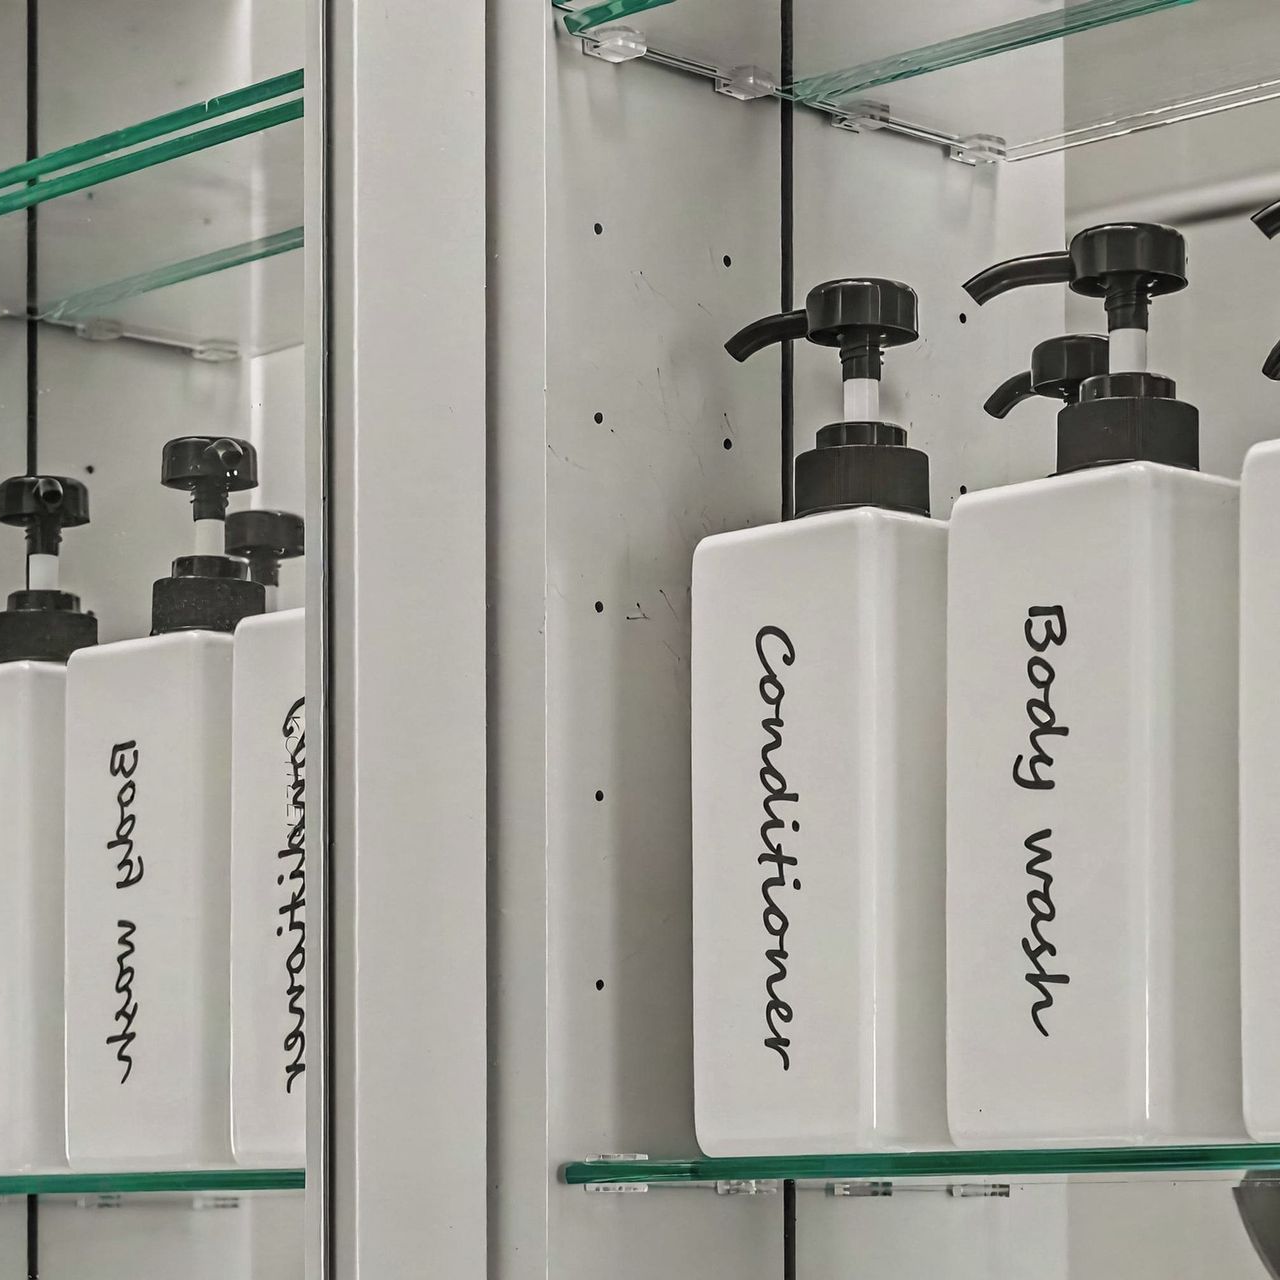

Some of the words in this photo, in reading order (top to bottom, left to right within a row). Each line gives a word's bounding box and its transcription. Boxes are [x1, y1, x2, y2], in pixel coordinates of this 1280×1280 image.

[1012, 604, 1070, 791] Body
[755, 625, 802, 1071] Conditioner
[1021, 828, 1071, 1038] wash
